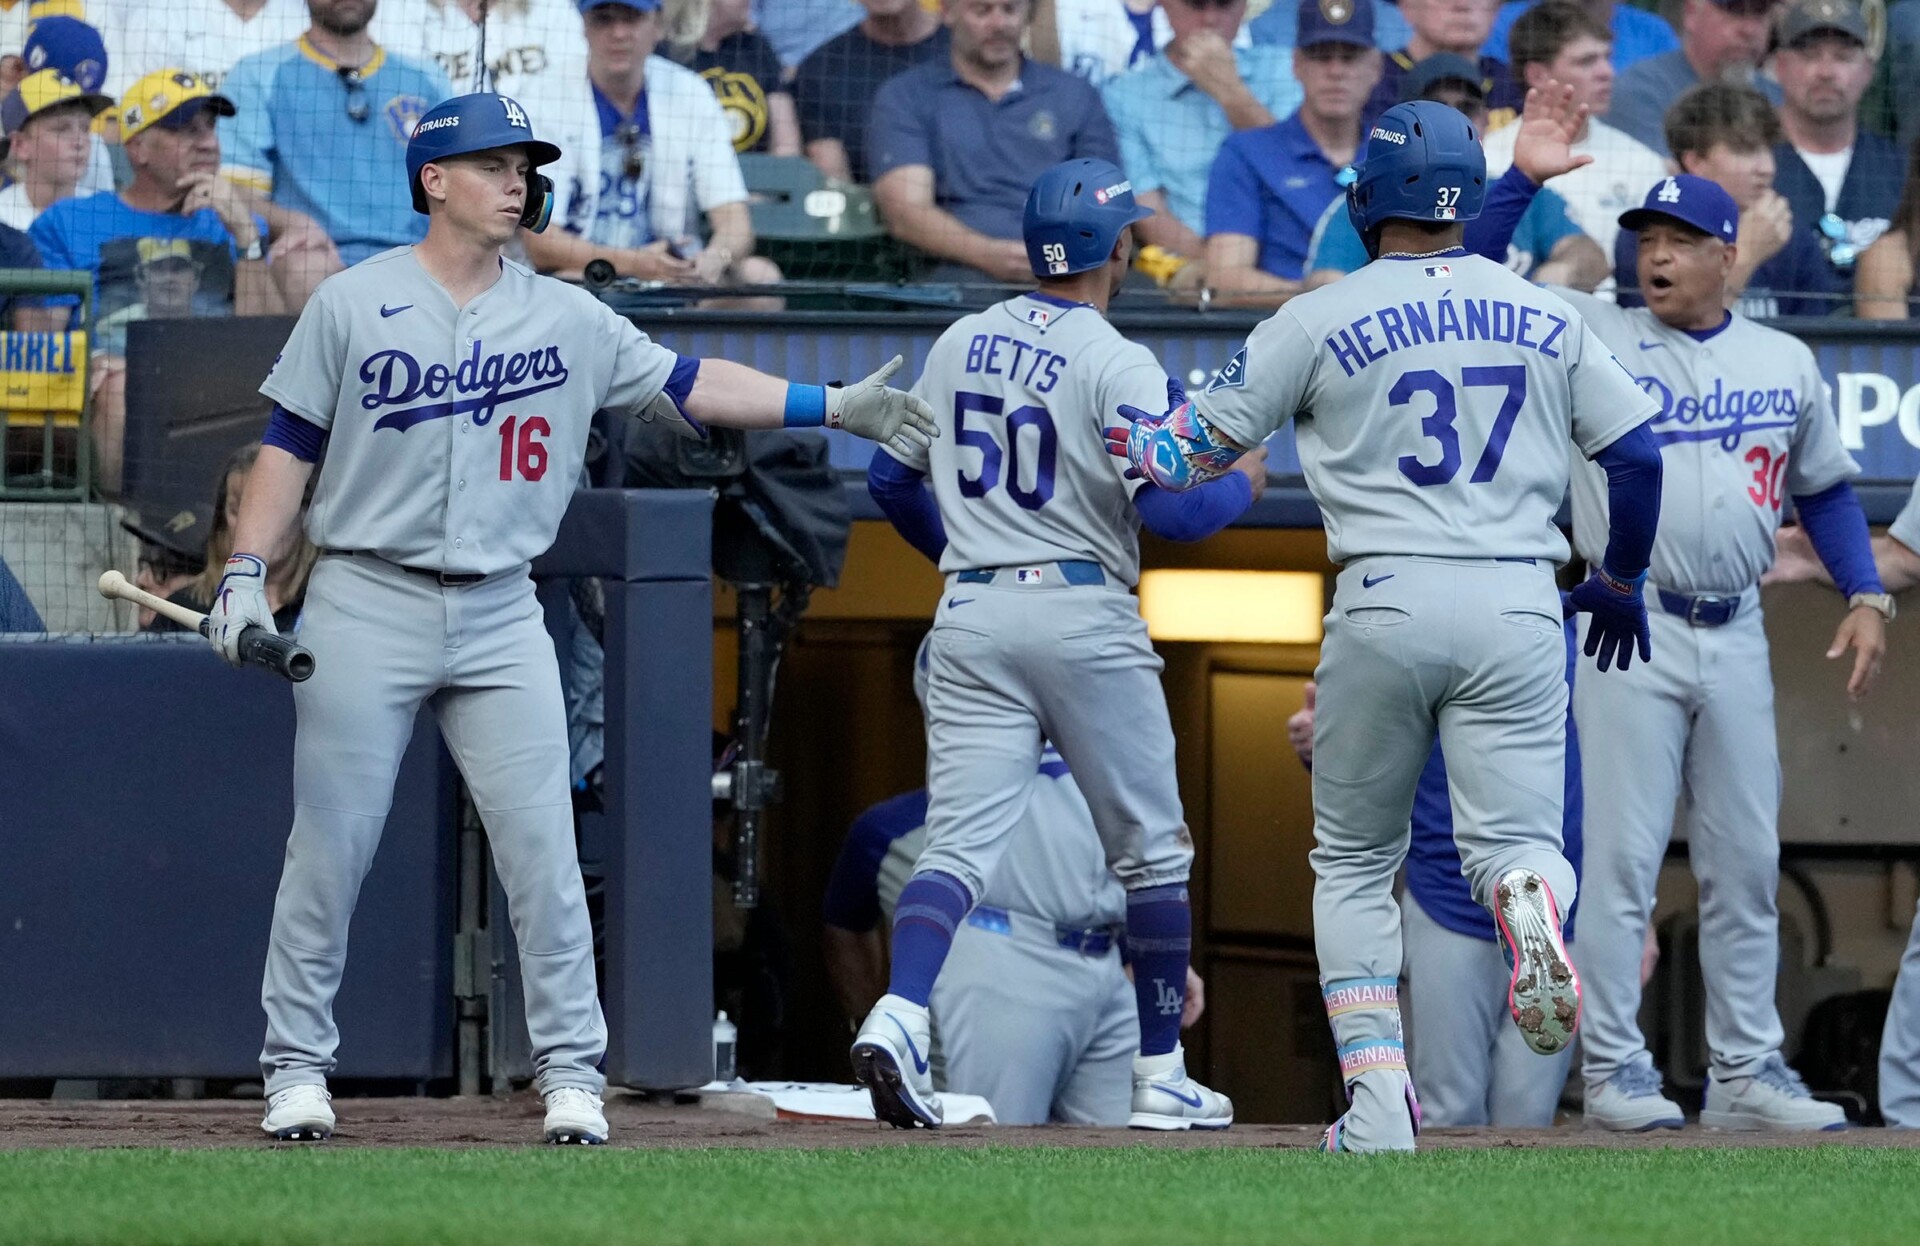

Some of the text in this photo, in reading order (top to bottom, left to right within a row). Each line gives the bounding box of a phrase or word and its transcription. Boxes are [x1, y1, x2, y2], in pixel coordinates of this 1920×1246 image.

[419, 115, 460, 134] STRAUSS
[499, 97, 527, 129] LA
[1373, 127, 1407, 146] STRAUSS
[1436, 187, 1461, 207] 37
[1042, 242, 1066, 262] 50
[0, 332, 75, 373] RREL
[1326, 289, 1567, 378] HERNÁNDEZ
[359, 339, 568, 434] Dodgers
[965, 334, 1067, 394] BETTS
[1387, 364, 1527, 487] 37
[1637, 376, 1799, 453] Dodgers
[498, 415, 551, 482] 16
[954, 391, 1058, 511] 50
[1744, 445, 1788, 511] 30
[1152, 978, 1184, 1015] LA
